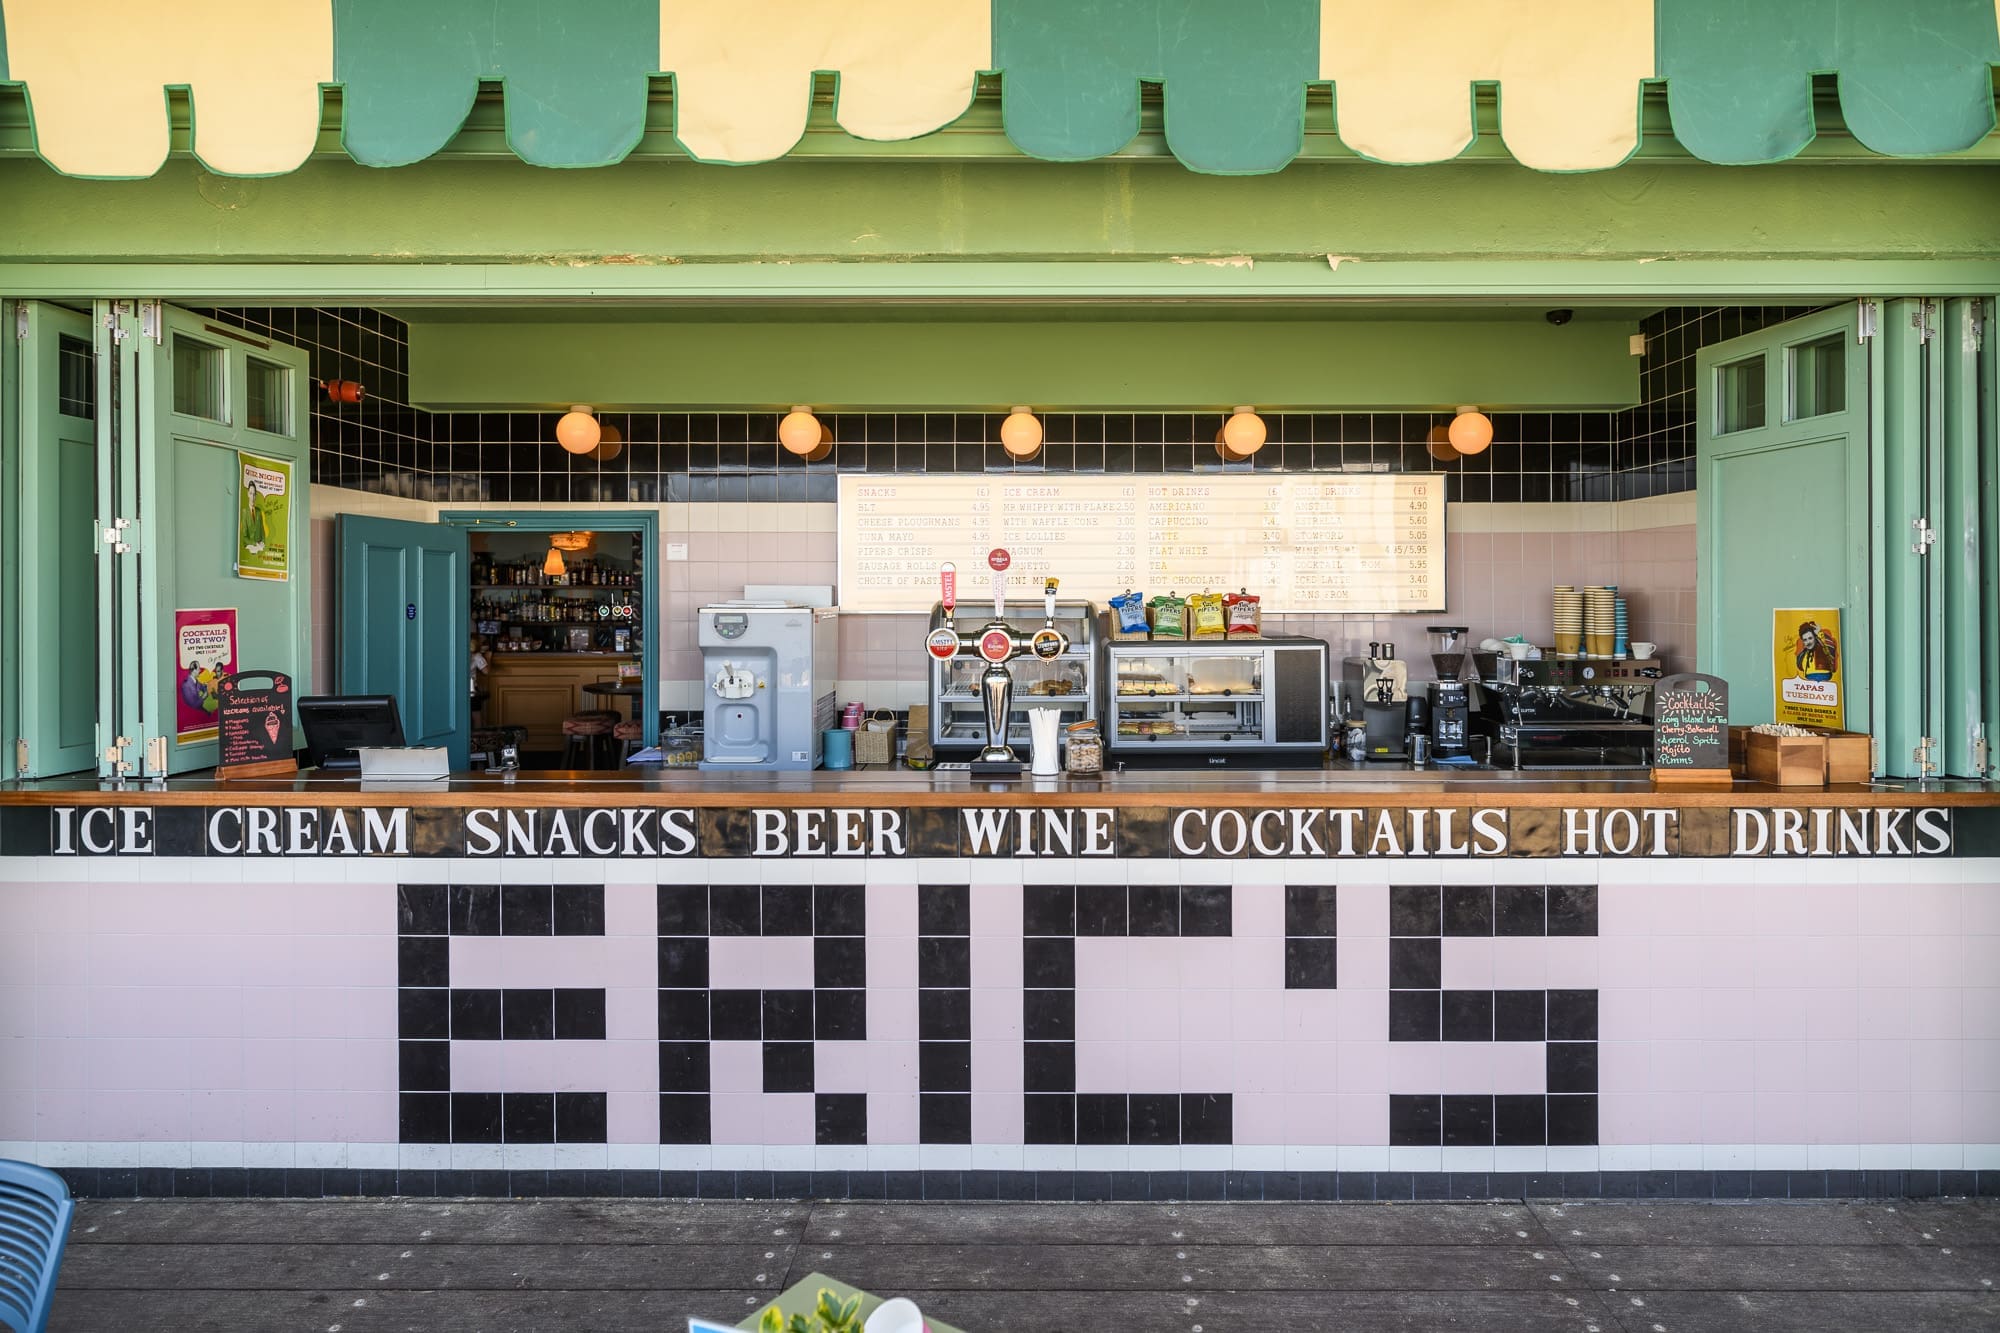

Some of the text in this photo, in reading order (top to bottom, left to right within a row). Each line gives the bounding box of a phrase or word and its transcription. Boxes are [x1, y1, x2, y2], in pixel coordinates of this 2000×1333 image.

[258, 472, 284, 482] NIGHT
[858, 488, 896, 497] SNACKS
[1004, 488, 1021, 496] ICE
[1026, 488, 1060, 496] CREAM
[1148, 488, 1168, 496] HOT
[1172, 488, 1210, 496] DRINKS
[1326, 487, 1360, 496] DRINKS
[858, 504, 990, 512] BLT 4.95
[1149, 503, 1205, 511] AMERICANO
[1409, 502, 1427, 510] 4.90
[858, 518, 990, 526] CHEESE PLOUGHMANS 4.95
[1149, 518, 1208, 526] CAPPUCCINO
[1409, 516, 1427, 524] 5.60
[858, 533, 990, 541] TUNA MAYO 4.95
[1004, 532, 1020, 540] ICE
[1026, 532, 1066, 540] LOLLIES
[1149, 532, 1178, 540] LATTE
[1409, 532, 1427, 540] 5.05
[858, 548, 990, 556] PIPERS CRISPS 1.20
[1149, 546, 1174, 555] FLAT
[1180, 546, 1208, 555] WHITE
[858, 562, 900, 570] SAUSAGE
[907, 562, 937, 570] ROLLS
[1150, 562, 1168, 570] TEA
[1296, 560, 1427, 569] COCKTAIL ROM 5.95
[858, 576, 990, 584] CHOICE OF PASTI 4.25
[1117, 576, 1134, 584] 1.25
[1149, 576, 1168, 584] HOT
[1172, 576, 1226, 584] CHOCOLATE
[1409, 576, 1427, 584] 3.40
[1296, 590, 1320, 598] CANS
[1410, 590, 1427, 598] 1.70
[1122, 605, 1143, 613] PIPERS
[182, 628, 228, 637] COCKTAILS
[1794, 683, 1825, 692] TAPAS
[230, 695, 260, 704] Selection
[1786, 691, 1835, 702] TUESDAYS
[1668, 696, 1715, 710] Cocktails
[1662, 714, 1680, 727] Long
[1682, 714, 1704, 724] Island
[1662, 724, 1720, 736] Cherry Bakewell
[1661, 734, 1720, 747] Aperol Spritz
[1661, 744, 1690, 757] Mojito
[1660, 754, 1694, 765] Pimms
[54, 807, 1952, 857] ICE CREAM SNACKS BEER WINE COCKTAILS HOT DRINKS
[399, 884, 1598, 1145] ERIC'S
